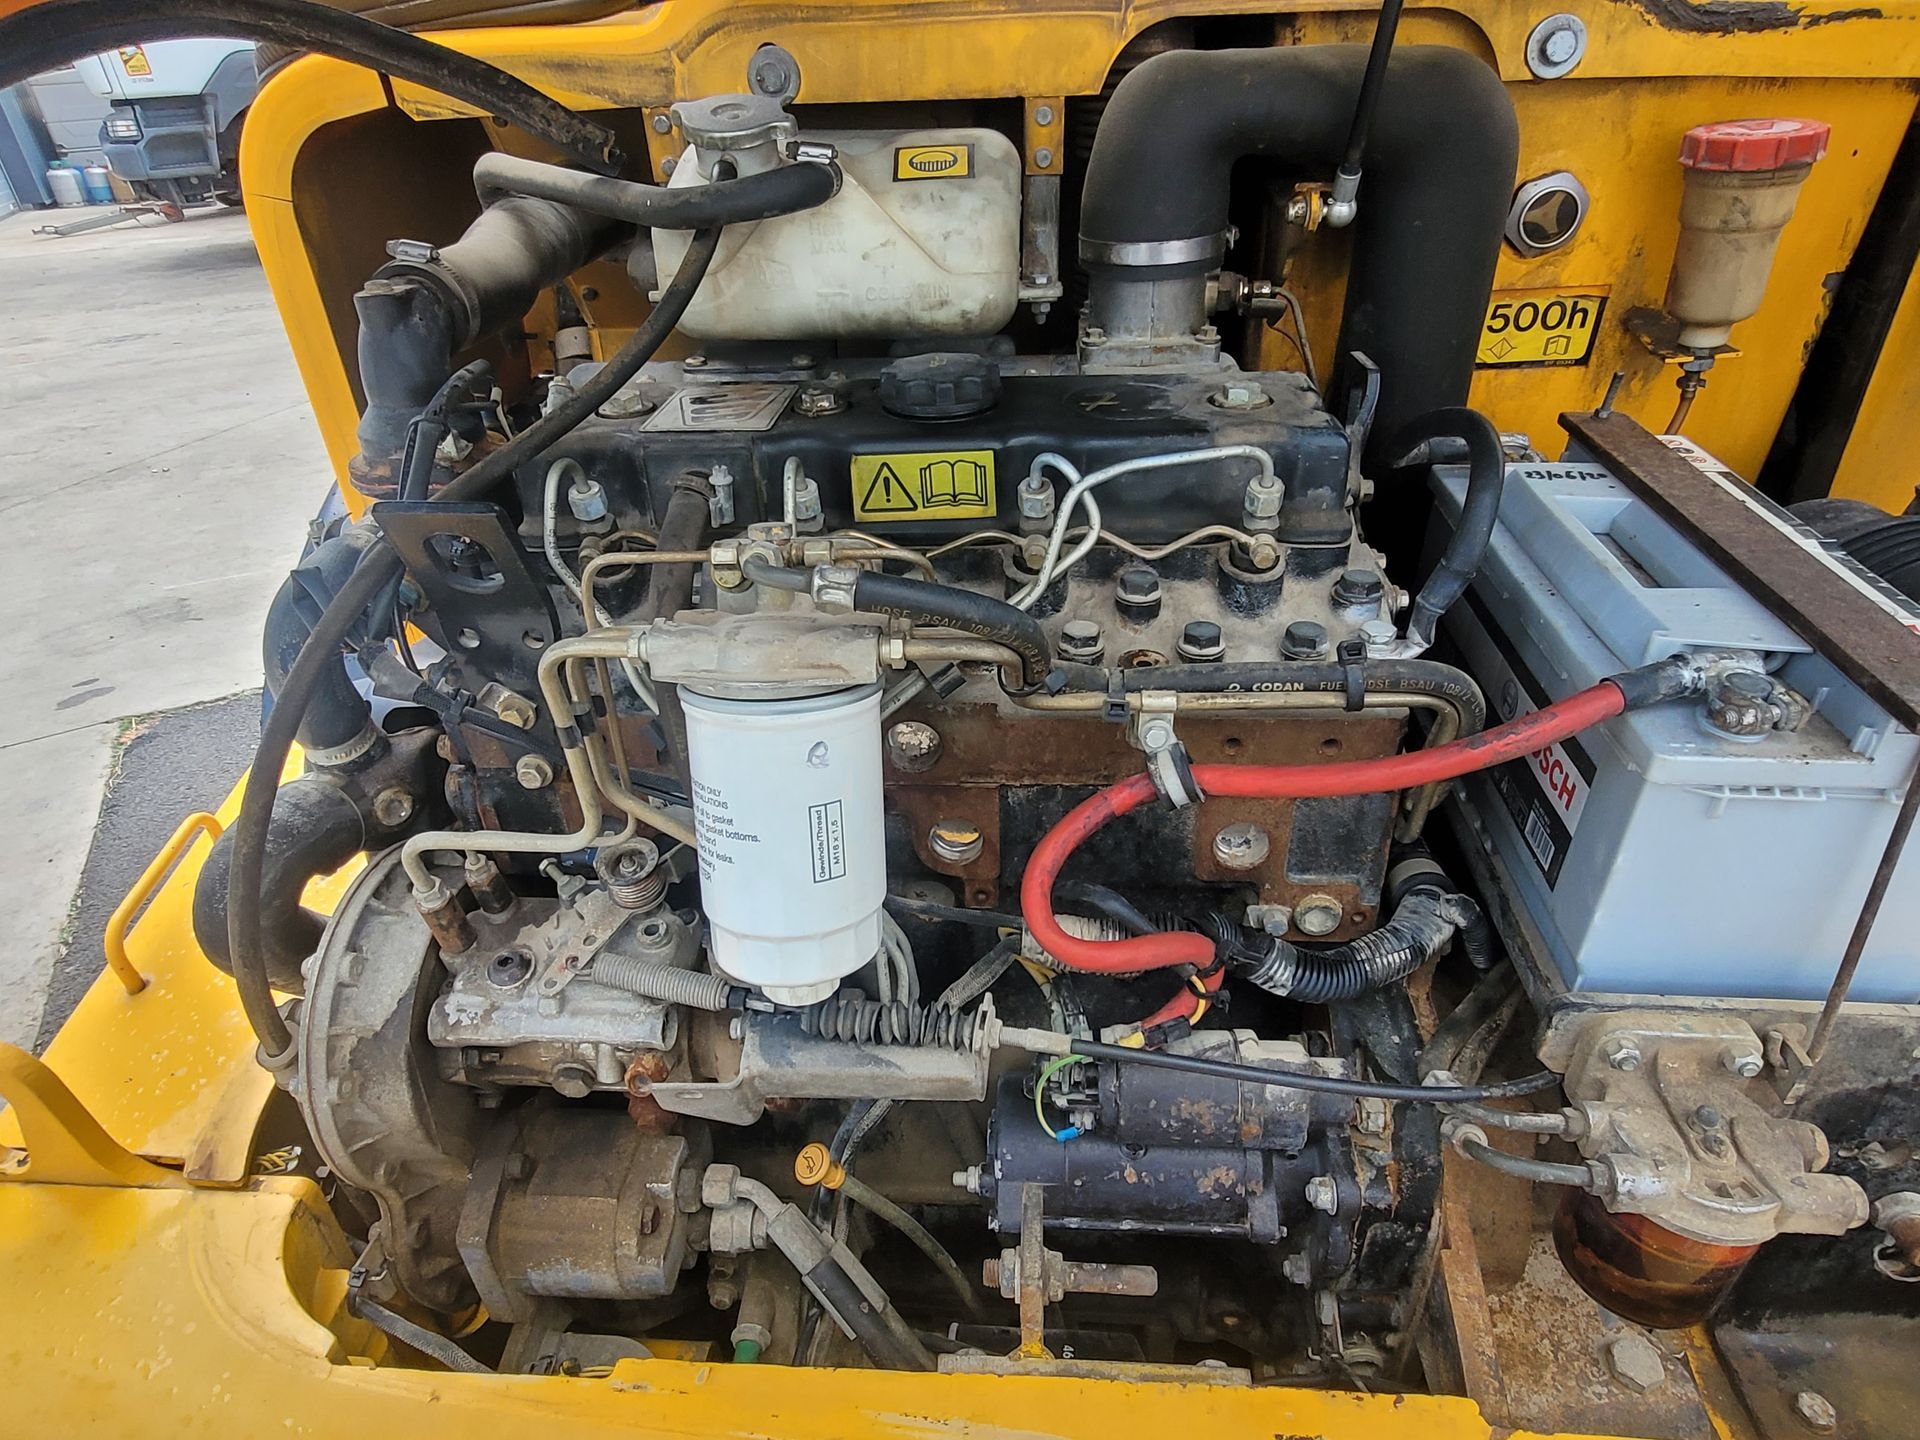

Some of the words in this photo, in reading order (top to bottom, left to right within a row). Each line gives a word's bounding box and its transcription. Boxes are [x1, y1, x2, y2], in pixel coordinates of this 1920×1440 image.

[1486, 300, 1590, 334] 500h
[1252, 682, 1304, 692] CODAN
[725, 830, 761, 843] bottoms.
